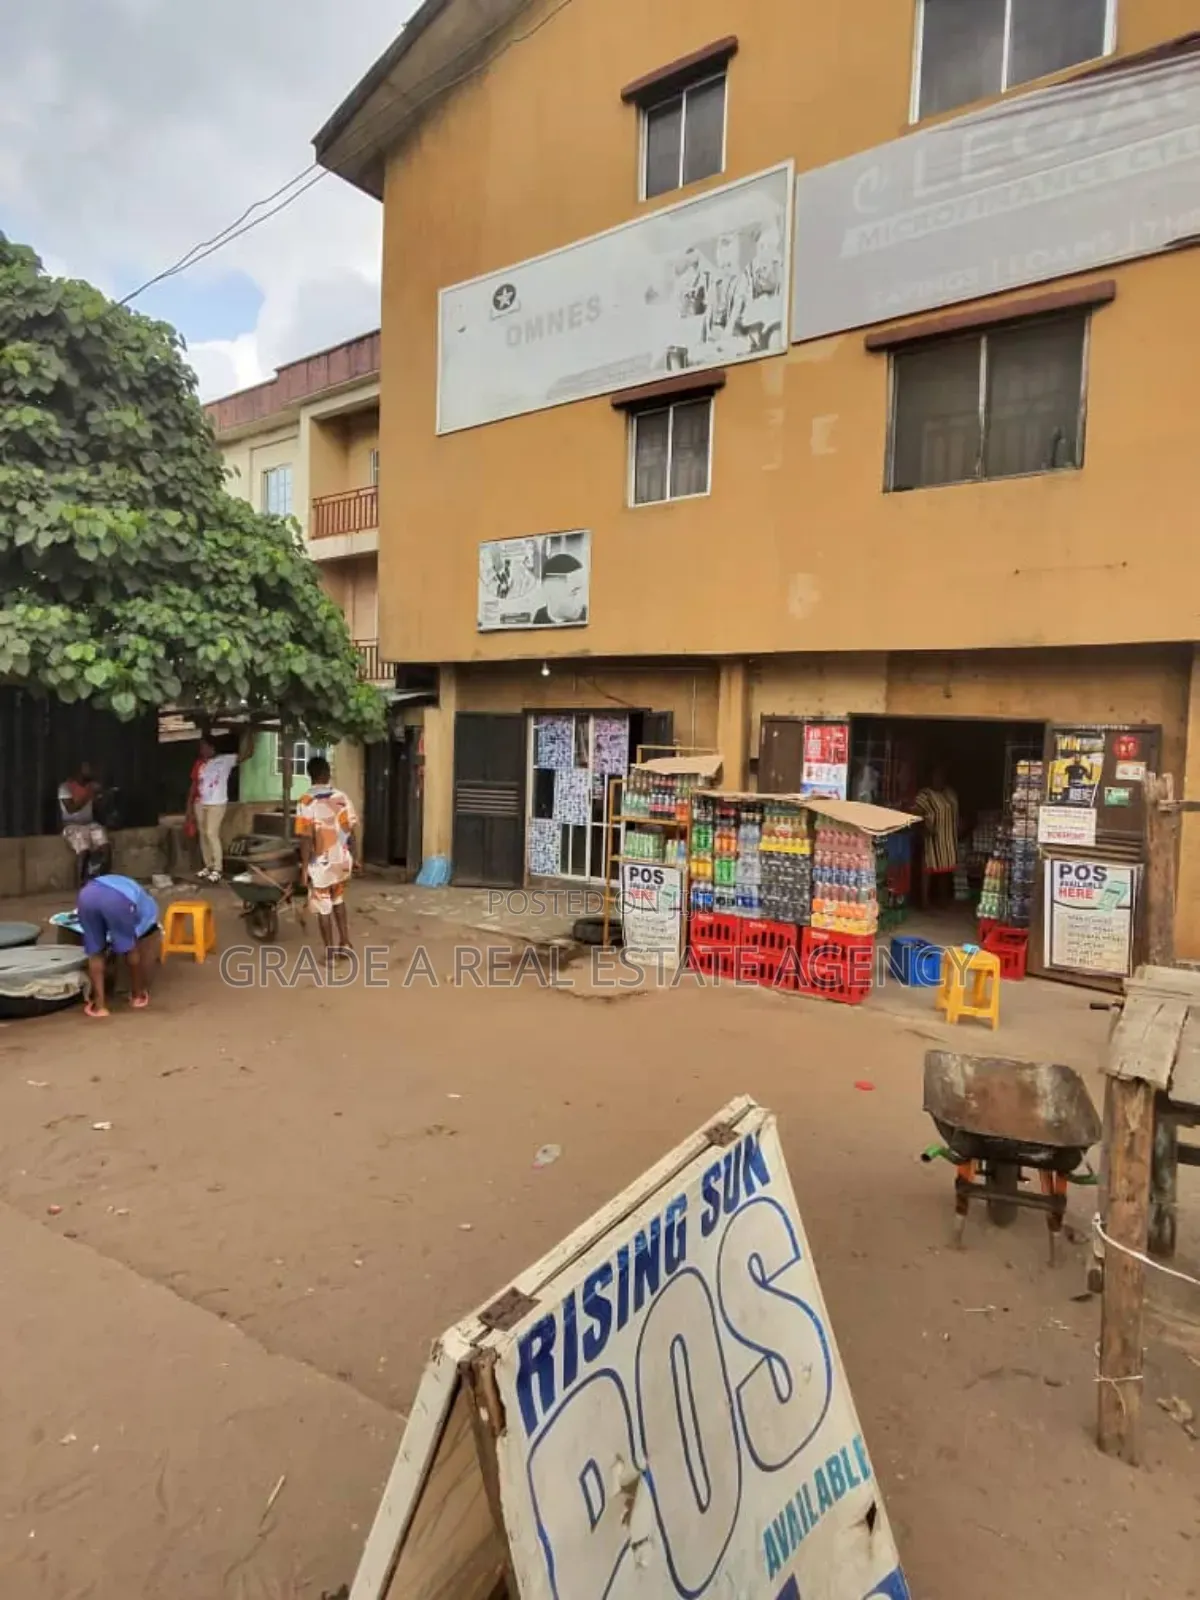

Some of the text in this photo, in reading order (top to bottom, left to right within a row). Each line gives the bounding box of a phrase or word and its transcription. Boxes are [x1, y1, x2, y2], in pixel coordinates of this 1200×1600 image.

[506, 294, 602, 349] OMNES
[629, 866, 664, 885] POS
[1058, 887, 1093, 899] HERE
[1059, 863, 1107, 882] POS
[516, 1129, 771, 1438] RISING SUN
[526, 1195, 832, 1600] POS
[762, 1434, 872, 1581] AVAILABLE
